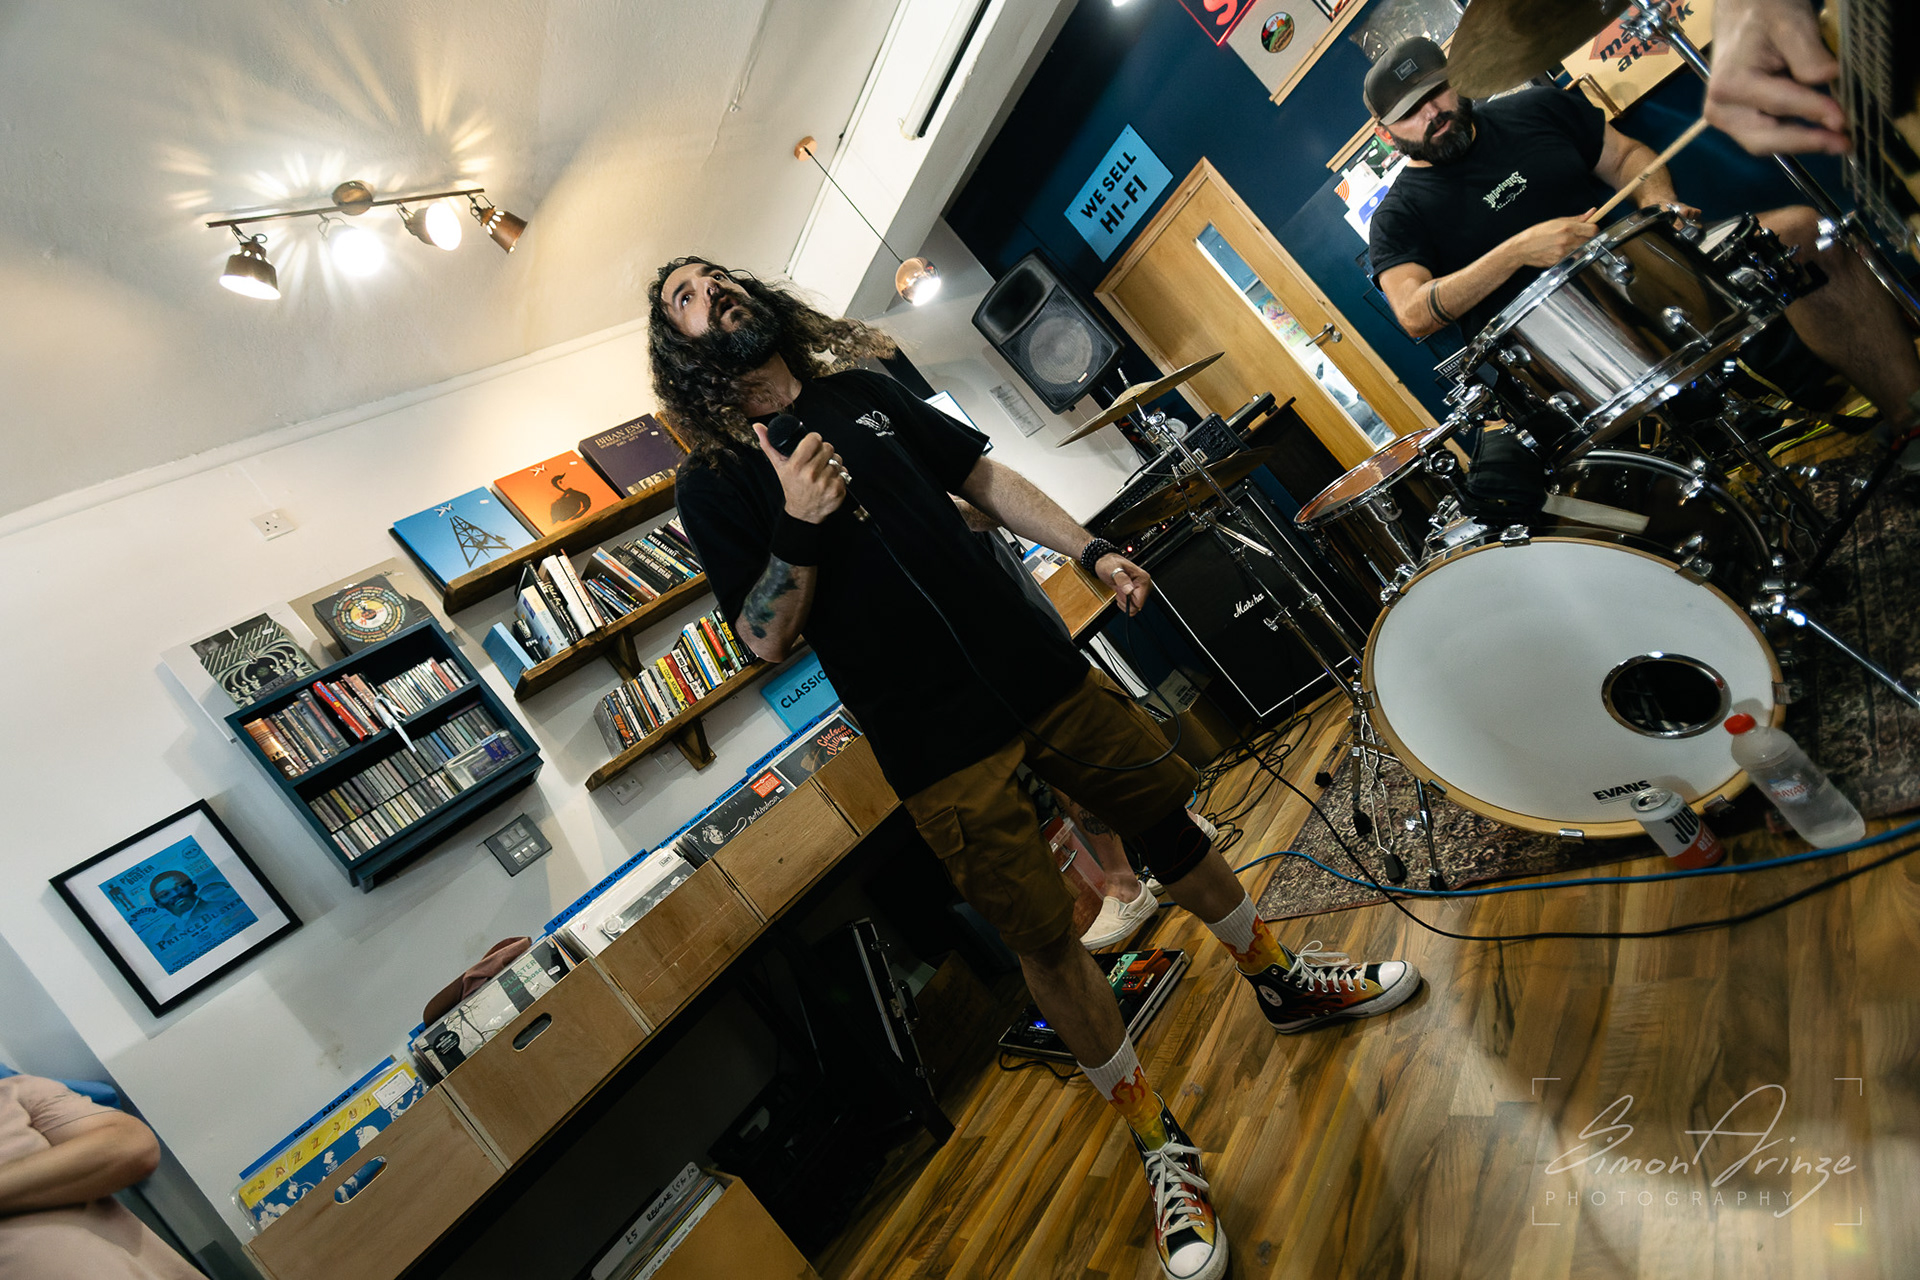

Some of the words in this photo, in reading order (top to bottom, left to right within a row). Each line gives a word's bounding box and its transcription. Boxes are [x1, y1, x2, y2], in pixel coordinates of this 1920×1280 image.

[1617, 2, 1694, 72] attk
[1080, 188, 1106, 218] WE
[1100, 151, 1137, 192] SELL
[1099, 173, 1148, 234] HI-FI
[594, 427, 625, 447] BRIAN
[624, 419, 645, 434] ENO
[1233, 593, 1265, 617] Marha
[1593, 780, 1652, 801] EVANS
[1665, 807, 1700, 844] JUB
[551, 906, 575, 926] LOCAL
[501, 959, 537, 988] CLUSTER
